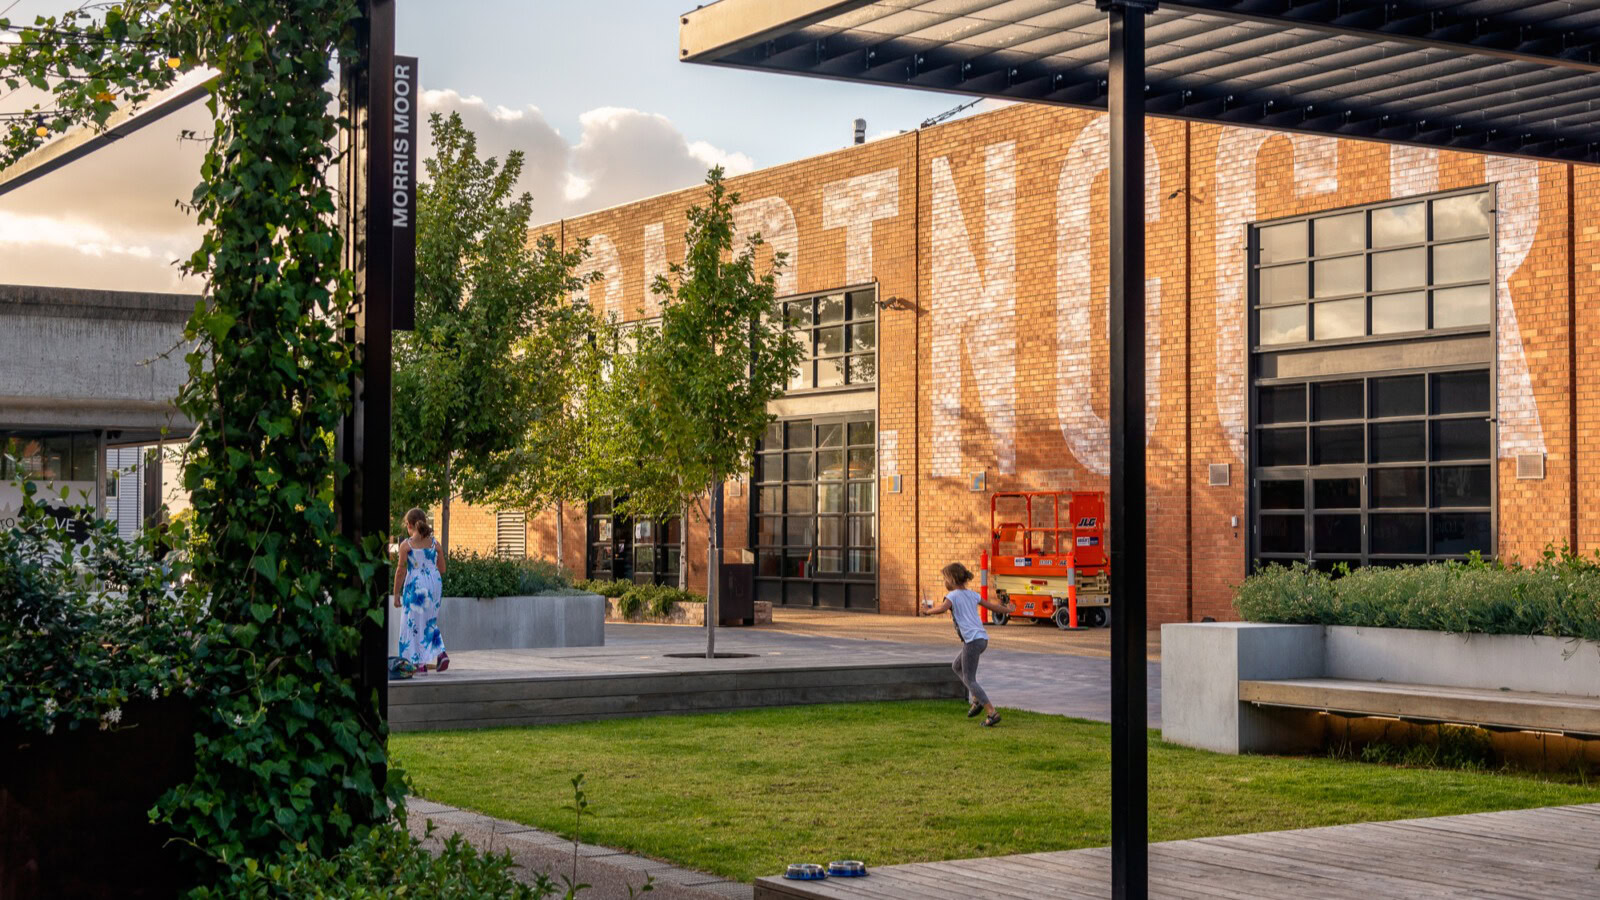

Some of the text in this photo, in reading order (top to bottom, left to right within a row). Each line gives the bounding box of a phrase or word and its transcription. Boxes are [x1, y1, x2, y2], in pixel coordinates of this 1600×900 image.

[393, 64, 410, 228] MORRIS MOOR
[1077, 517, 1096, 527] JLG
